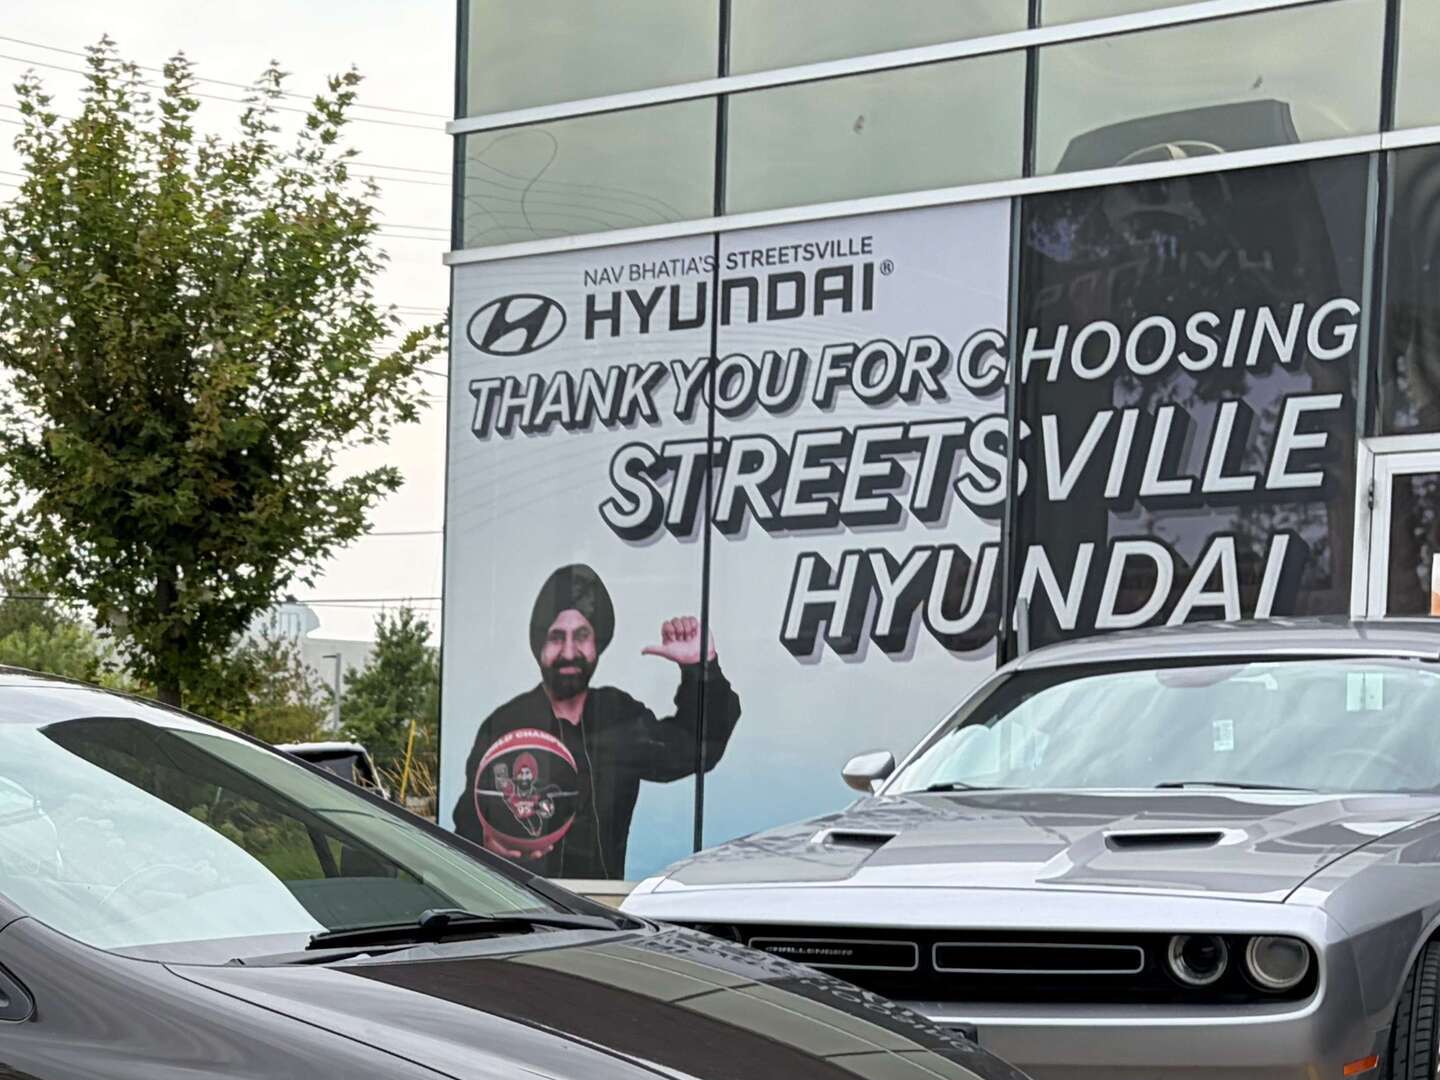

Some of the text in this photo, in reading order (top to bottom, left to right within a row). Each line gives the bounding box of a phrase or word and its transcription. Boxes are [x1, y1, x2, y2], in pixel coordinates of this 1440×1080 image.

[583, 235, 873, 287] NAV BHATIA'S STREETSVILLE
[469, 298, 1360, 435] THANK YOU FOR CHOOSING
[599, 394, 1343, 540] STREETSVILLE
[780, 532, 1298, 655] HYUNDAI
